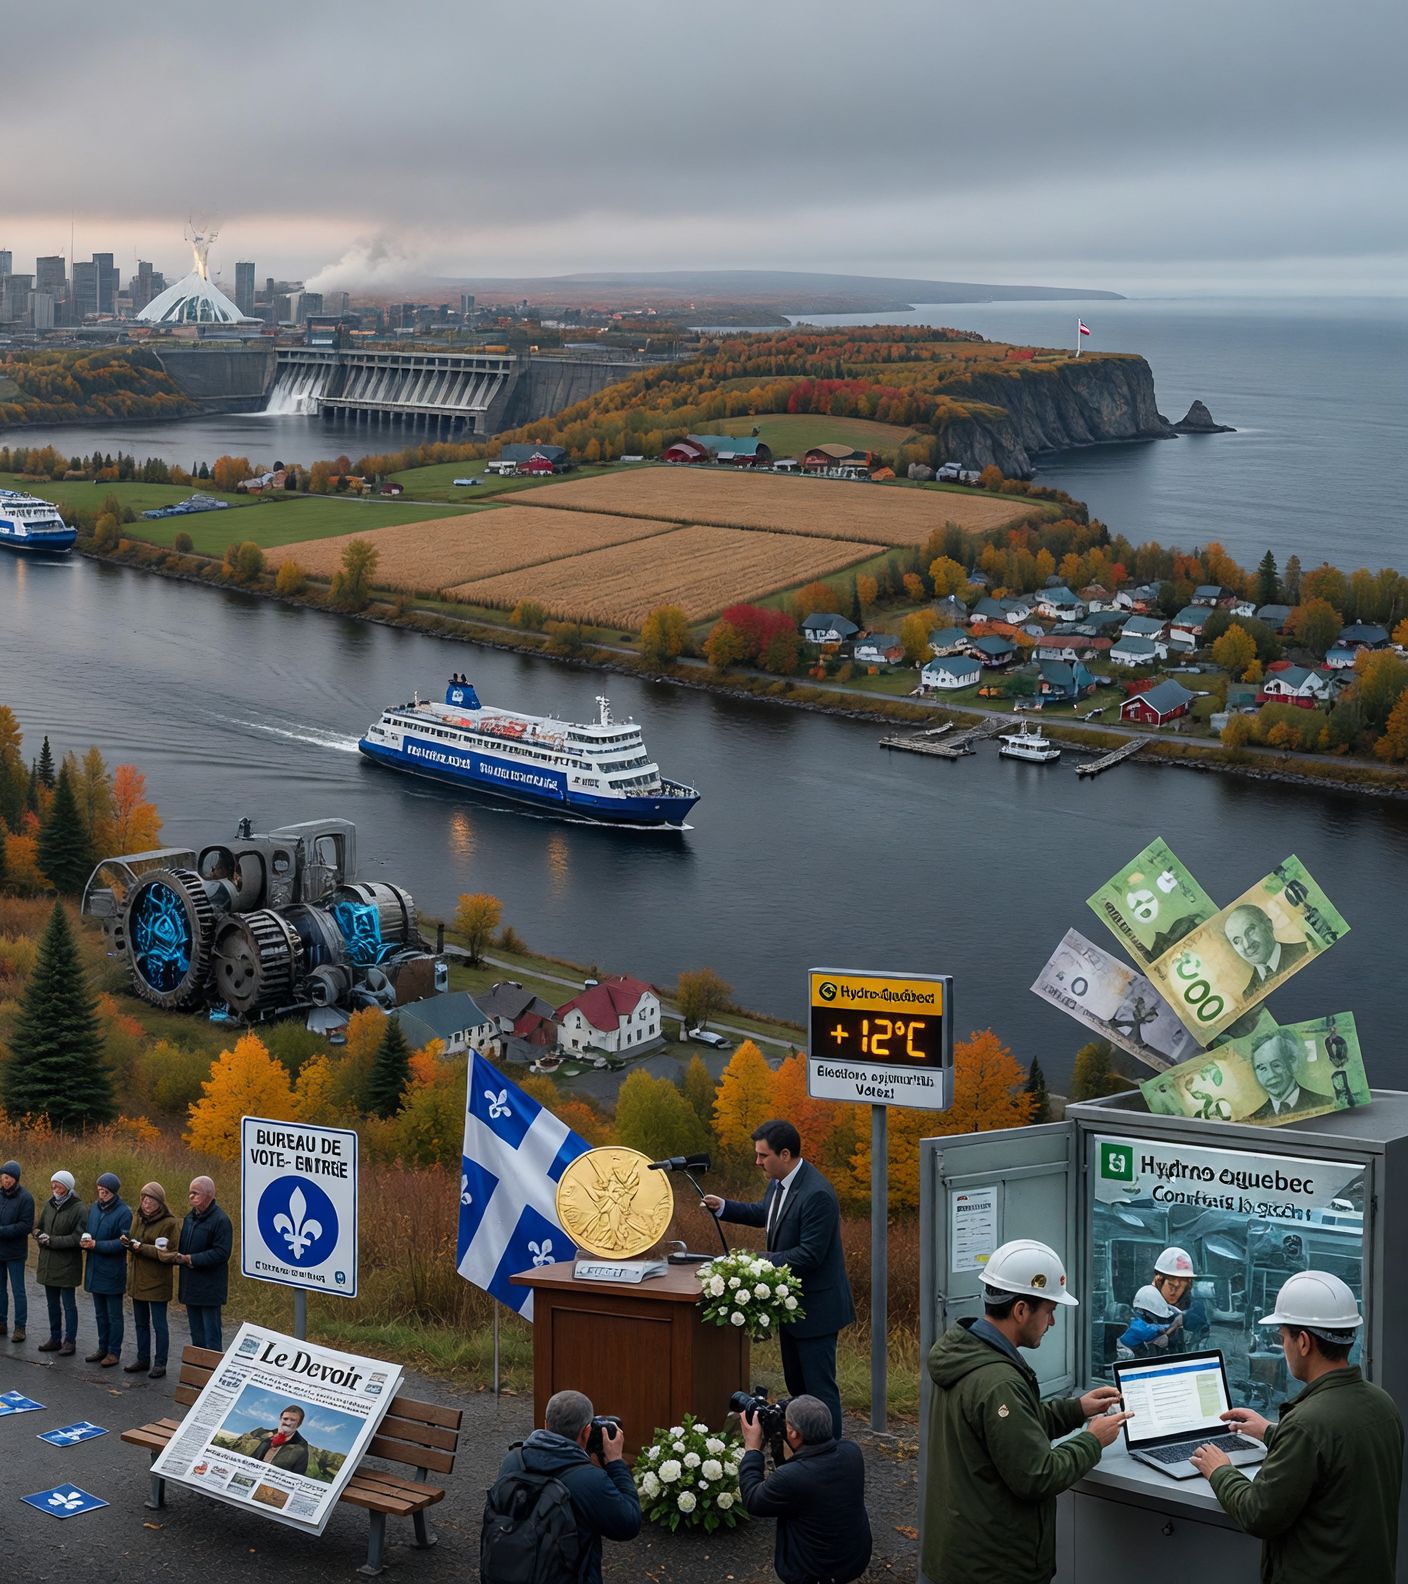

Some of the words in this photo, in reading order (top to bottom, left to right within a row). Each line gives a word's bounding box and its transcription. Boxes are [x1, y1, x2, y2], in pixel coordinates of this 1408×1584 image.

[257, 1129, 316, 1153] BUREAU
[321, 1137, 341, 1156] DE
[259, 1340, 289, 1368] Le
[287, 1350, 363, 1391] Devoir
